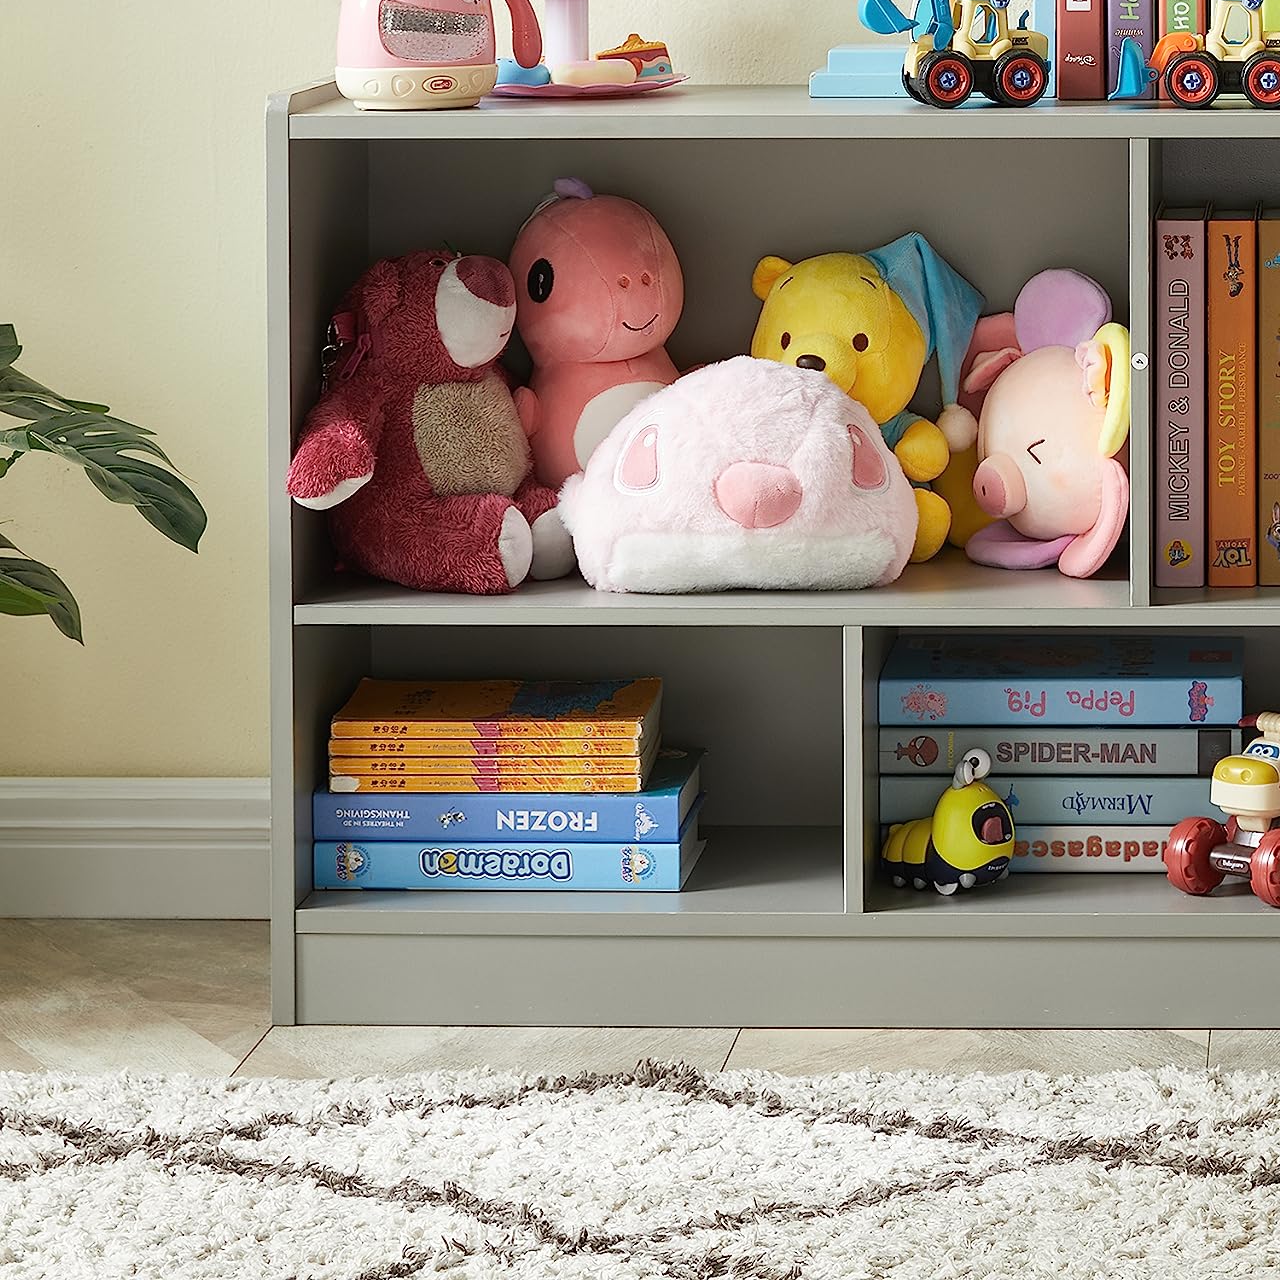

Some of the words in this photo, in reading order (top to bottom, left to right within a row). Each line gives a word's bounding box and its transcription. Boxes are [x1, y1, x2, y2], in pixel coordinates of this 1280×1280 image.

[1064, 53, 1097, 66] Disney
[1169, 278, 1191, 389] DONALD
[1218, 349, 1236, 427] STORY
[1169, 394, 1191, 414] &
[1169, 421, 1191, 521] MICKEY
[1218, 439, 1236, 488] TOY
[1212, 547, 1252, 568] TOY
[1217, 541, 1249, 549] STORY
[1004, 689, 1047, 717] Pig
[1066, 689, 1136, 717] Peppa
[996, 742, 1157, 765] SPIDER-MAN
[335, 809, 410, 819] THANKSGIVING
[496, 810, 598, 832] FROZEN
[1014, 836, 1167, 862] adagasca
[420, 848, 573, 882] Doraemon
